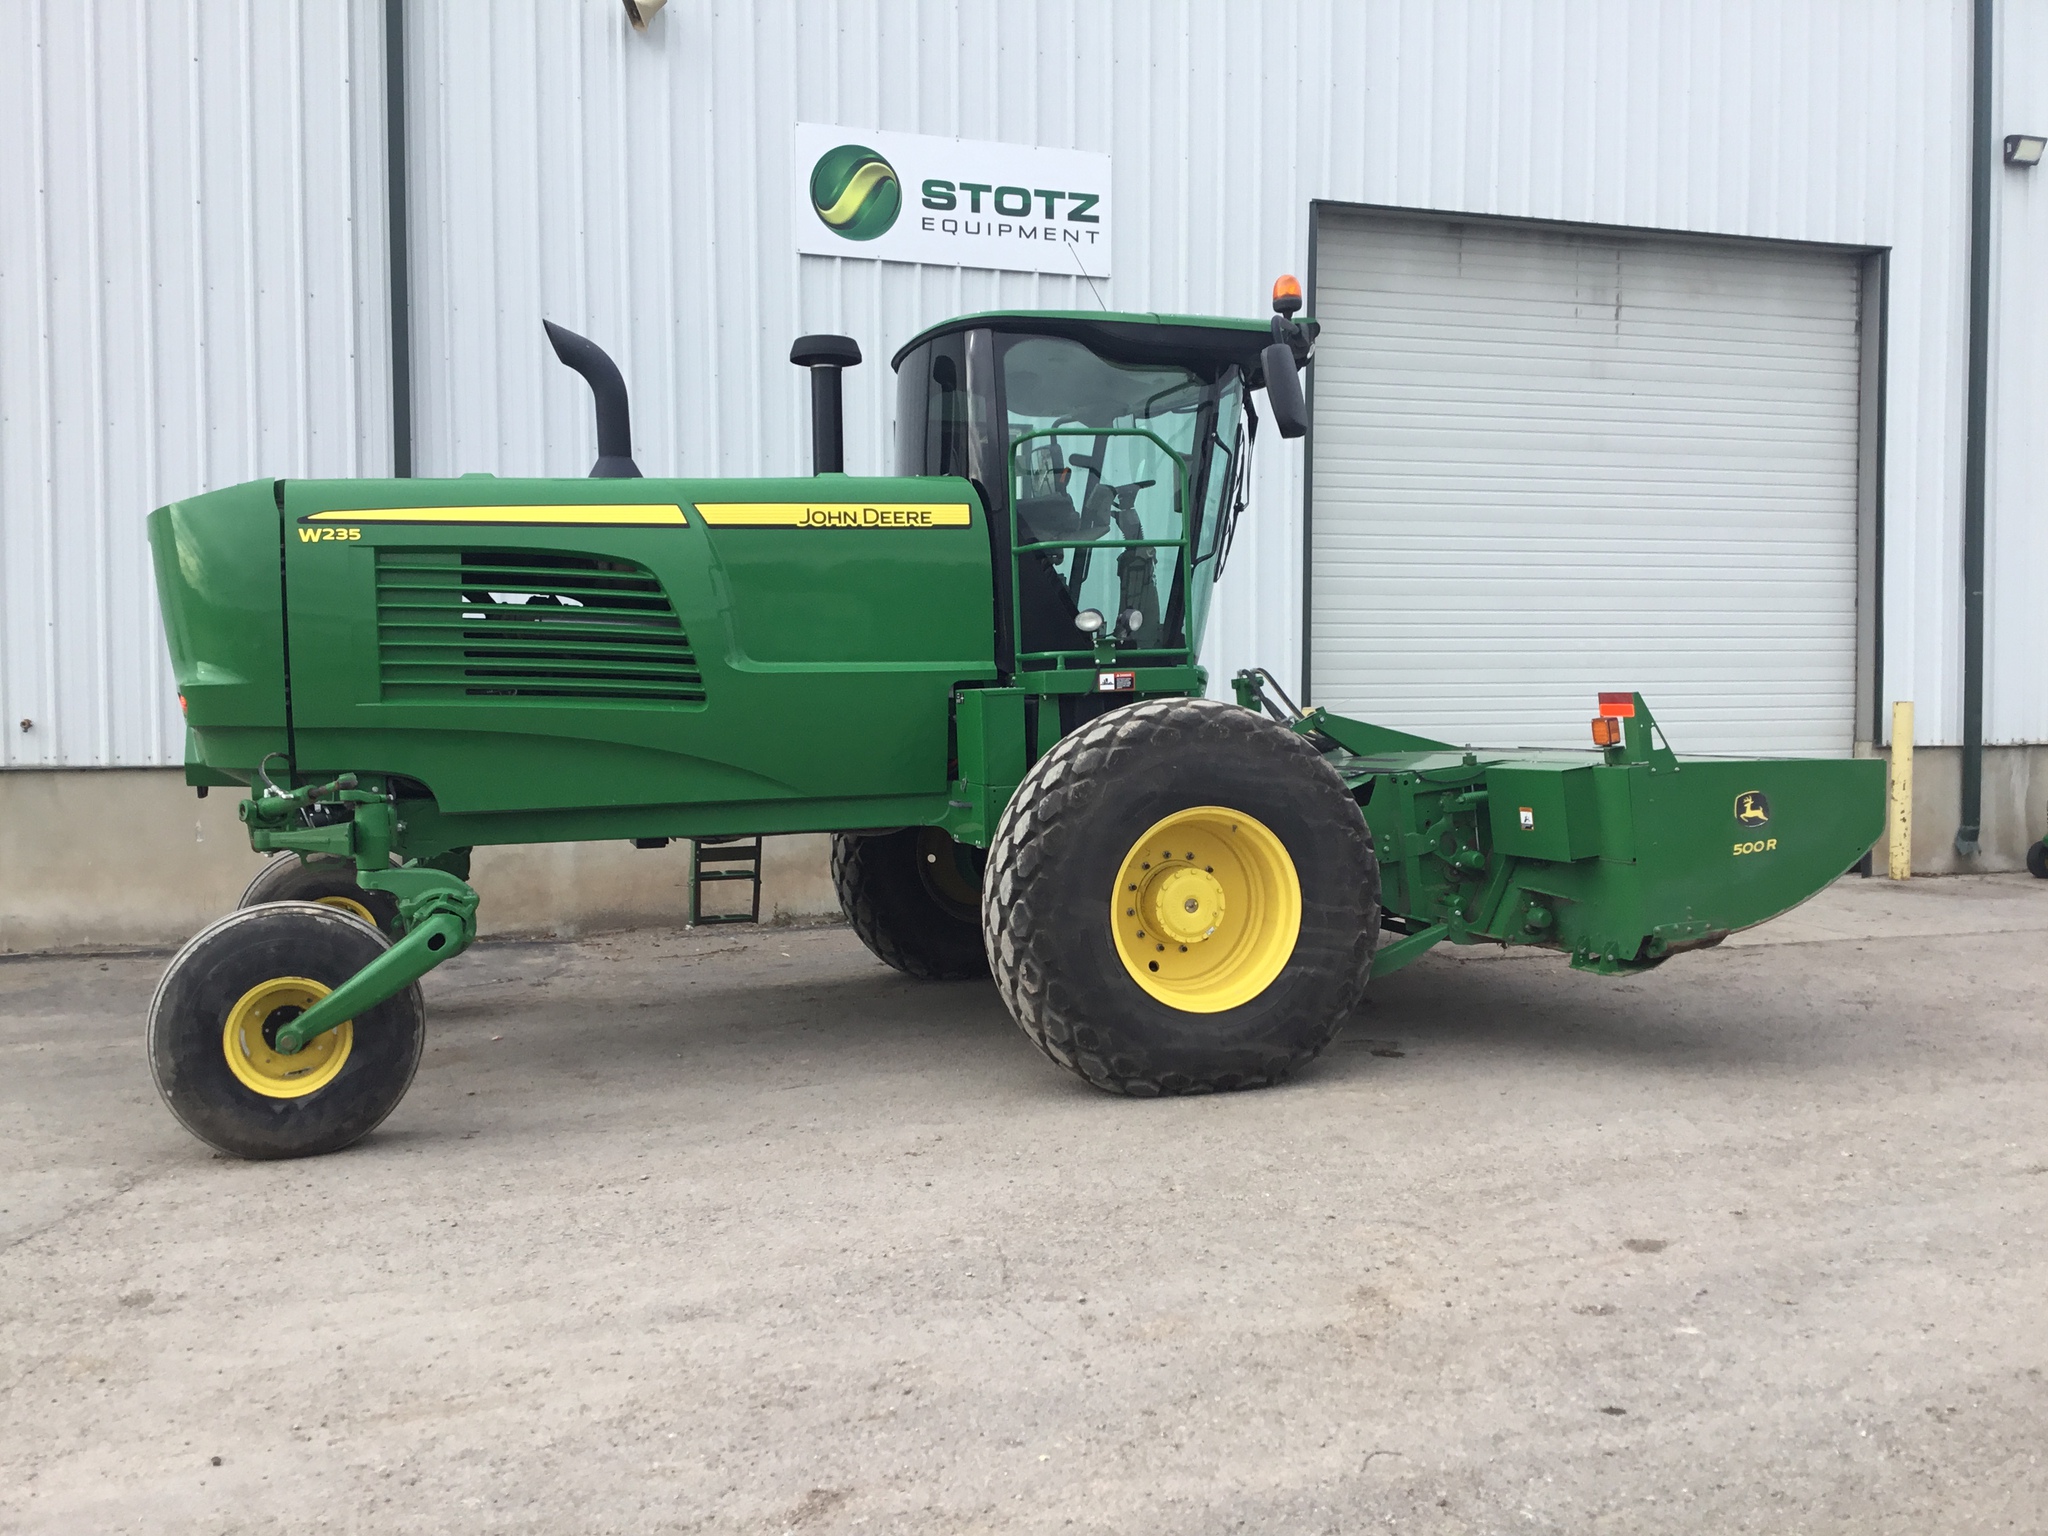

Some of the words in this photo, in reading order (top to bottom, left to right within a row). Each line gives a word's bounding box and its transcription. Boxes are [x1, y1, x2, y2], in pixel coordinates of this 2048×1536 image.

[921, 178, 1100, 224] STOTZ
[921, 216, 1100, 245] EQUIPMENT
[799, 507, 857, 525] JOHN
[863, 507, 933, 525] DEERE
[298, 527, 361, 543] W235
